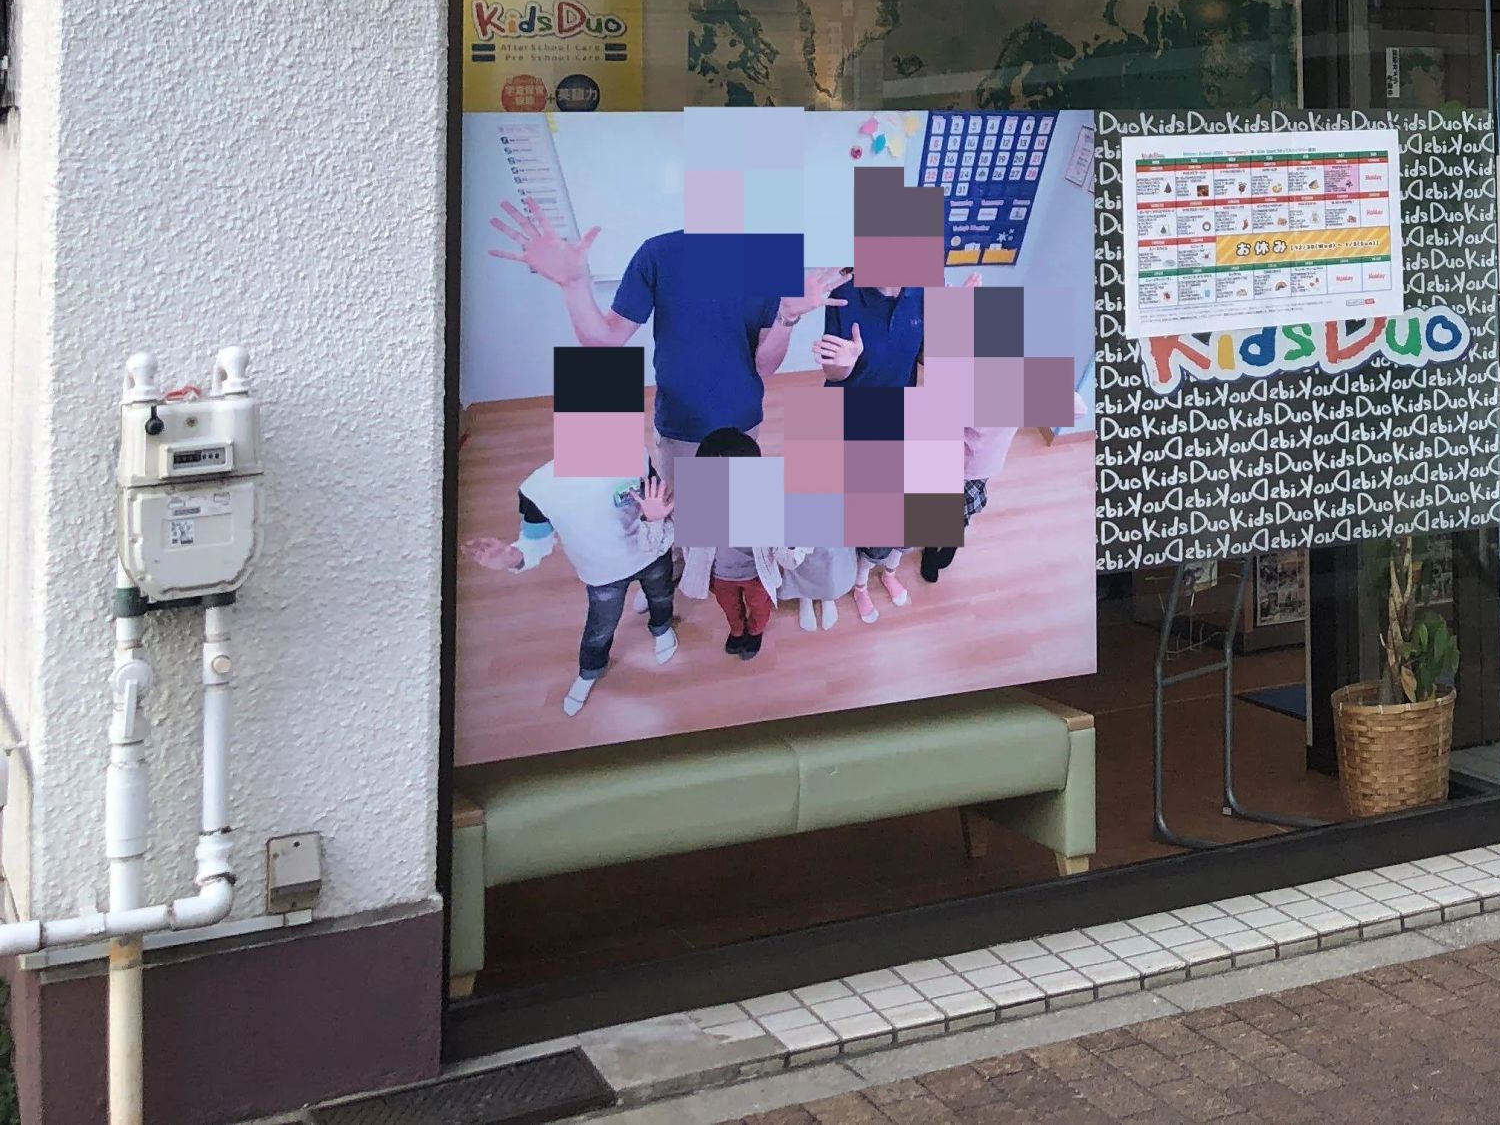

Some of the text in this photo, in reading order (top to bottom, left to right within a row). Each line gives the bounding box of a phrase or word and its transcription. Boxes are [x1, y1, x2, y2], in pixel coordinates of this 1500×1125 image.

[531, 53, 569, 62] School
[1236, 240, 1287, 256] お休み
